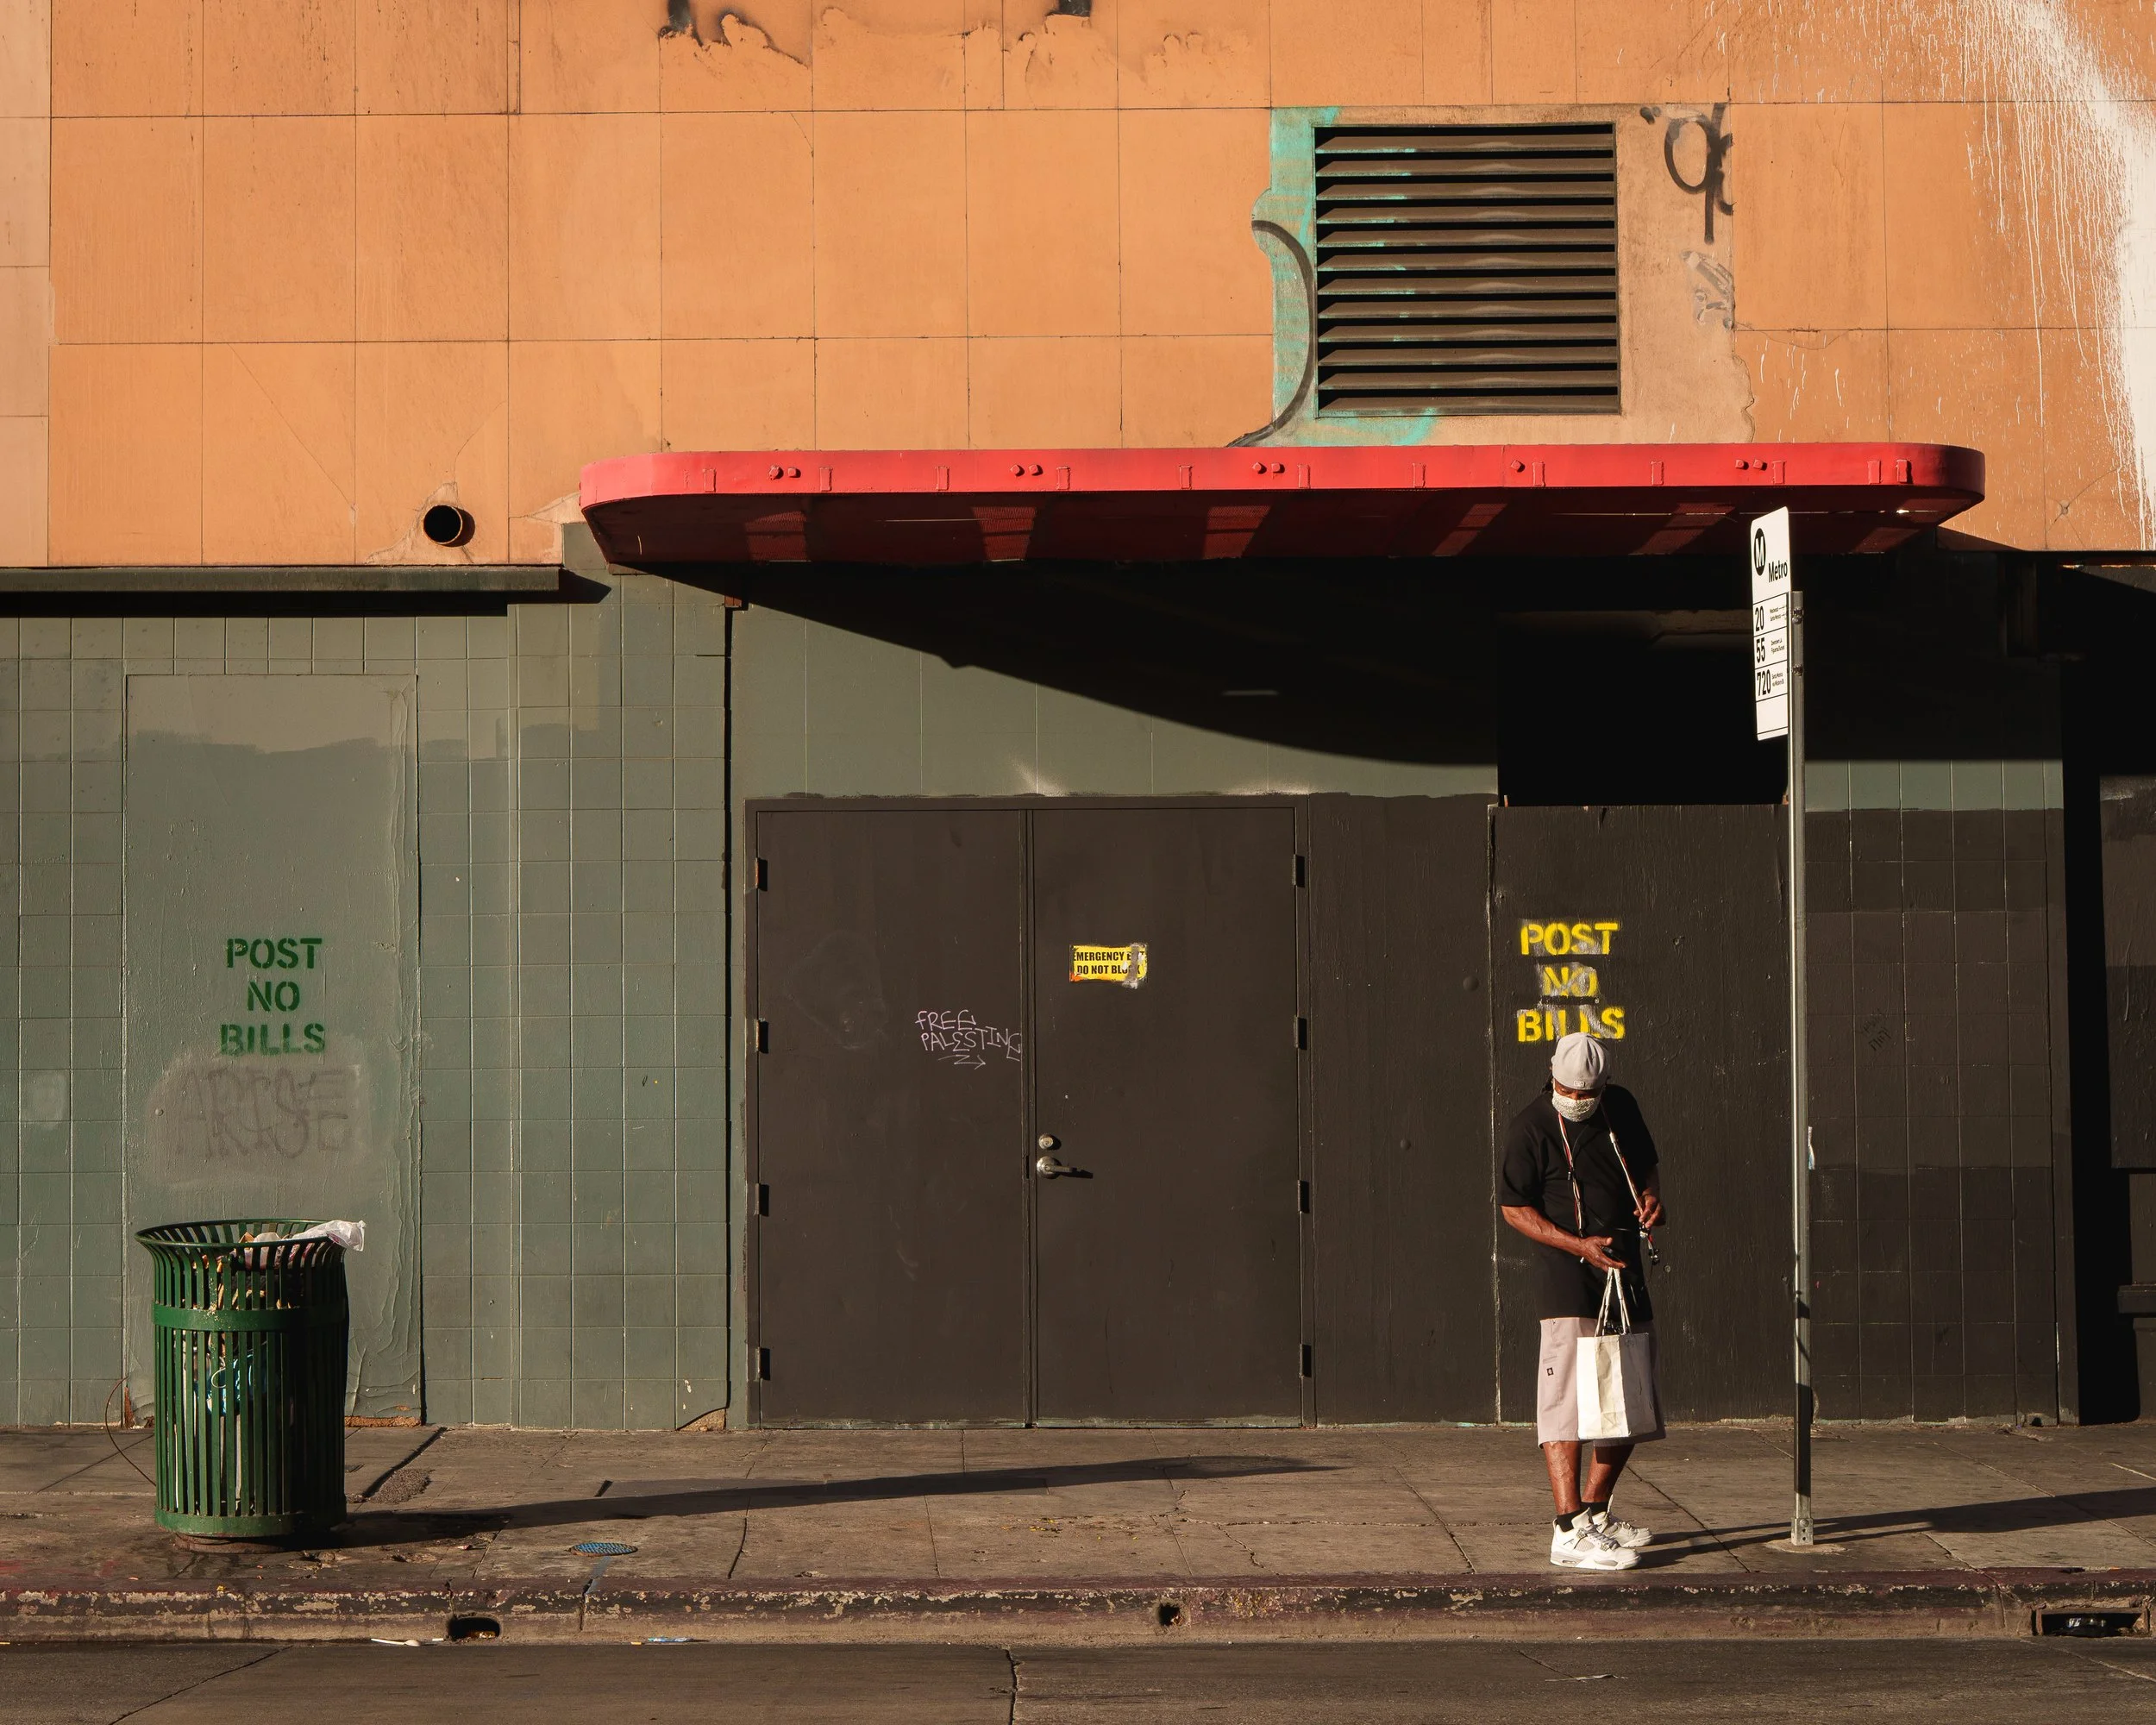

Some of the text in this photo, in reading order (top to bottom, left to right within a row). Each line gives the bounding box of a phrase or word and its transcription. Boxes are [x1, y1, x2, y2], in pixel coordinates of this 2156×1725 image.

[1769, 560, 1788, 583] Metro
[1755, 605, 1764, 631] 20
[1756, 637, 1766, 663] 55
[1757, 669, 1771, 696] 720
[1520, 923, 1619, 955] POST
[226, 938, 323, 969] POST
[1077, 964, 1088, 975] DO
[1091, 964, 1109, 975] NOT
[1543, 967, 1598, 997] NO
[248, 982, 301, 1012] NO
[221, 1024, 325, 1056] BILLS
